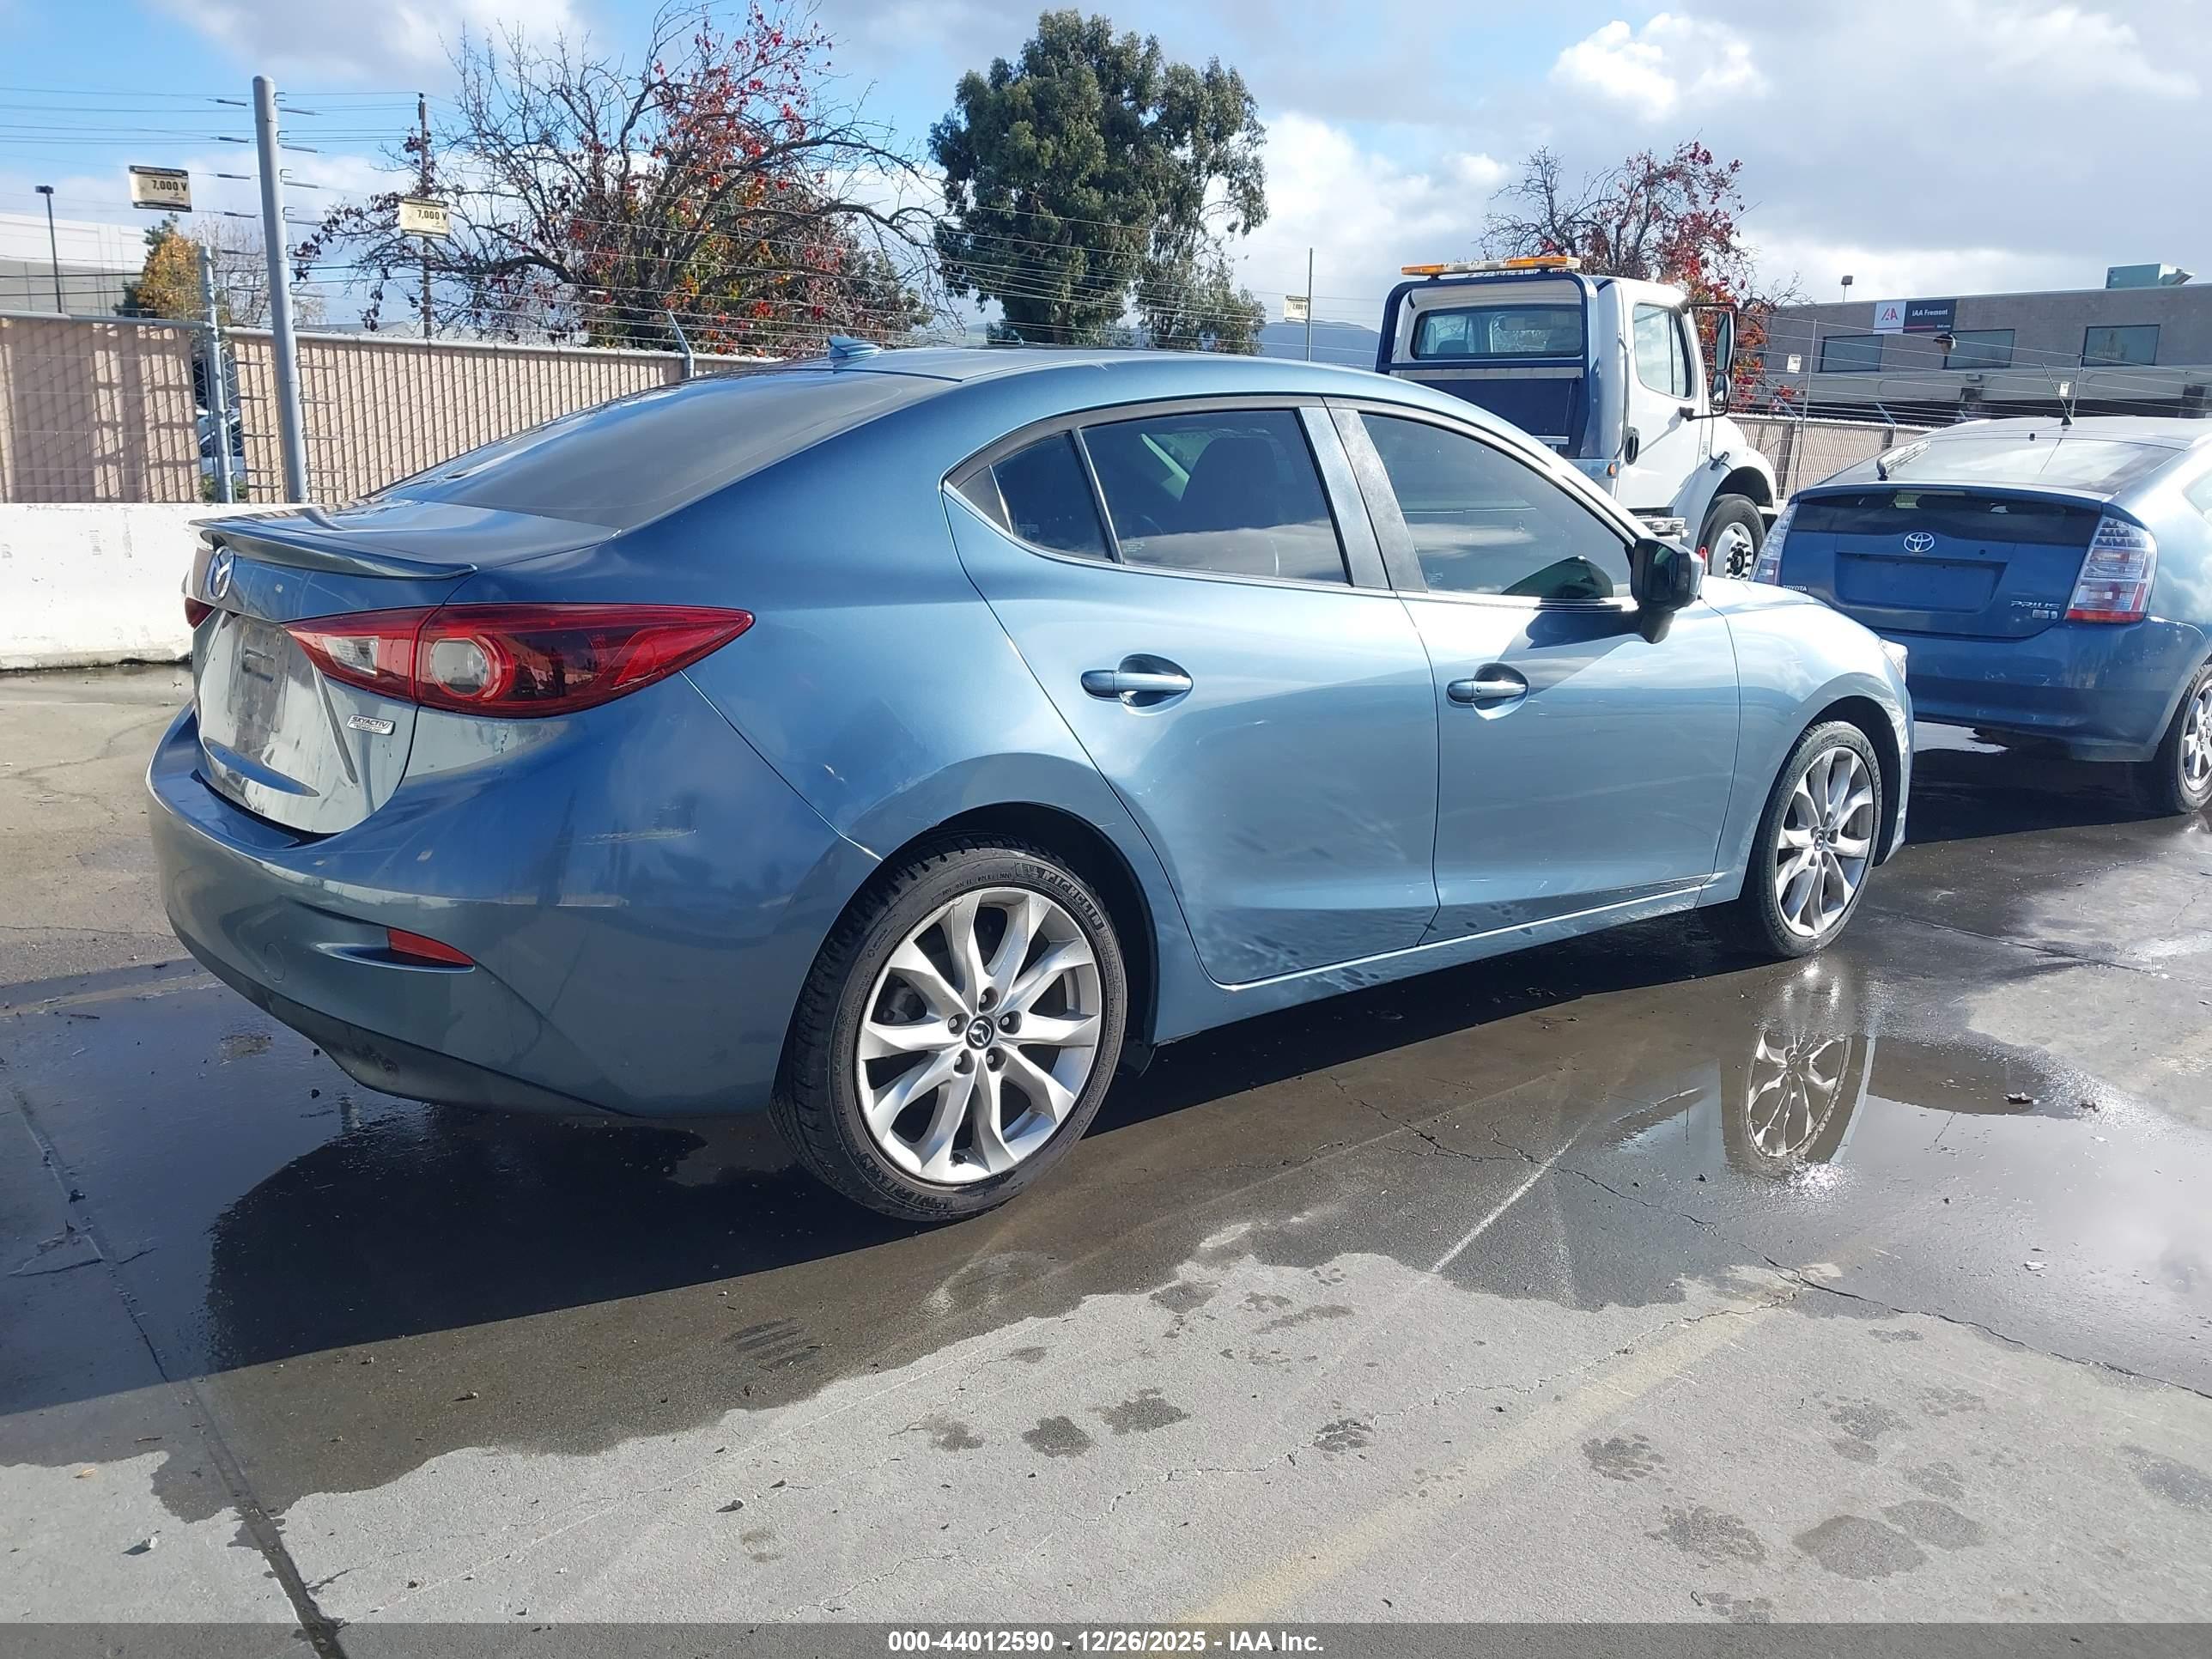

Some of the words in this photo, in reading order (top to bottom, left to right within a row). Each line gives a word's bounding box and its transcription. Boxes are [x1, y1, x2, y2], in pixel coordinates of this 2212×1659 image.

[151, 179, 179, 191] 7,000
[180, 182, 187, 191] V
[417, 210, 440, 220] 7,000
[442, 212, 447, 221] V
[2010, 600, 2061, 610] PRIUS
[352, 716, 389, 727] SKYACTIV
[1042, 867, 1103, 927] MICHELIN
